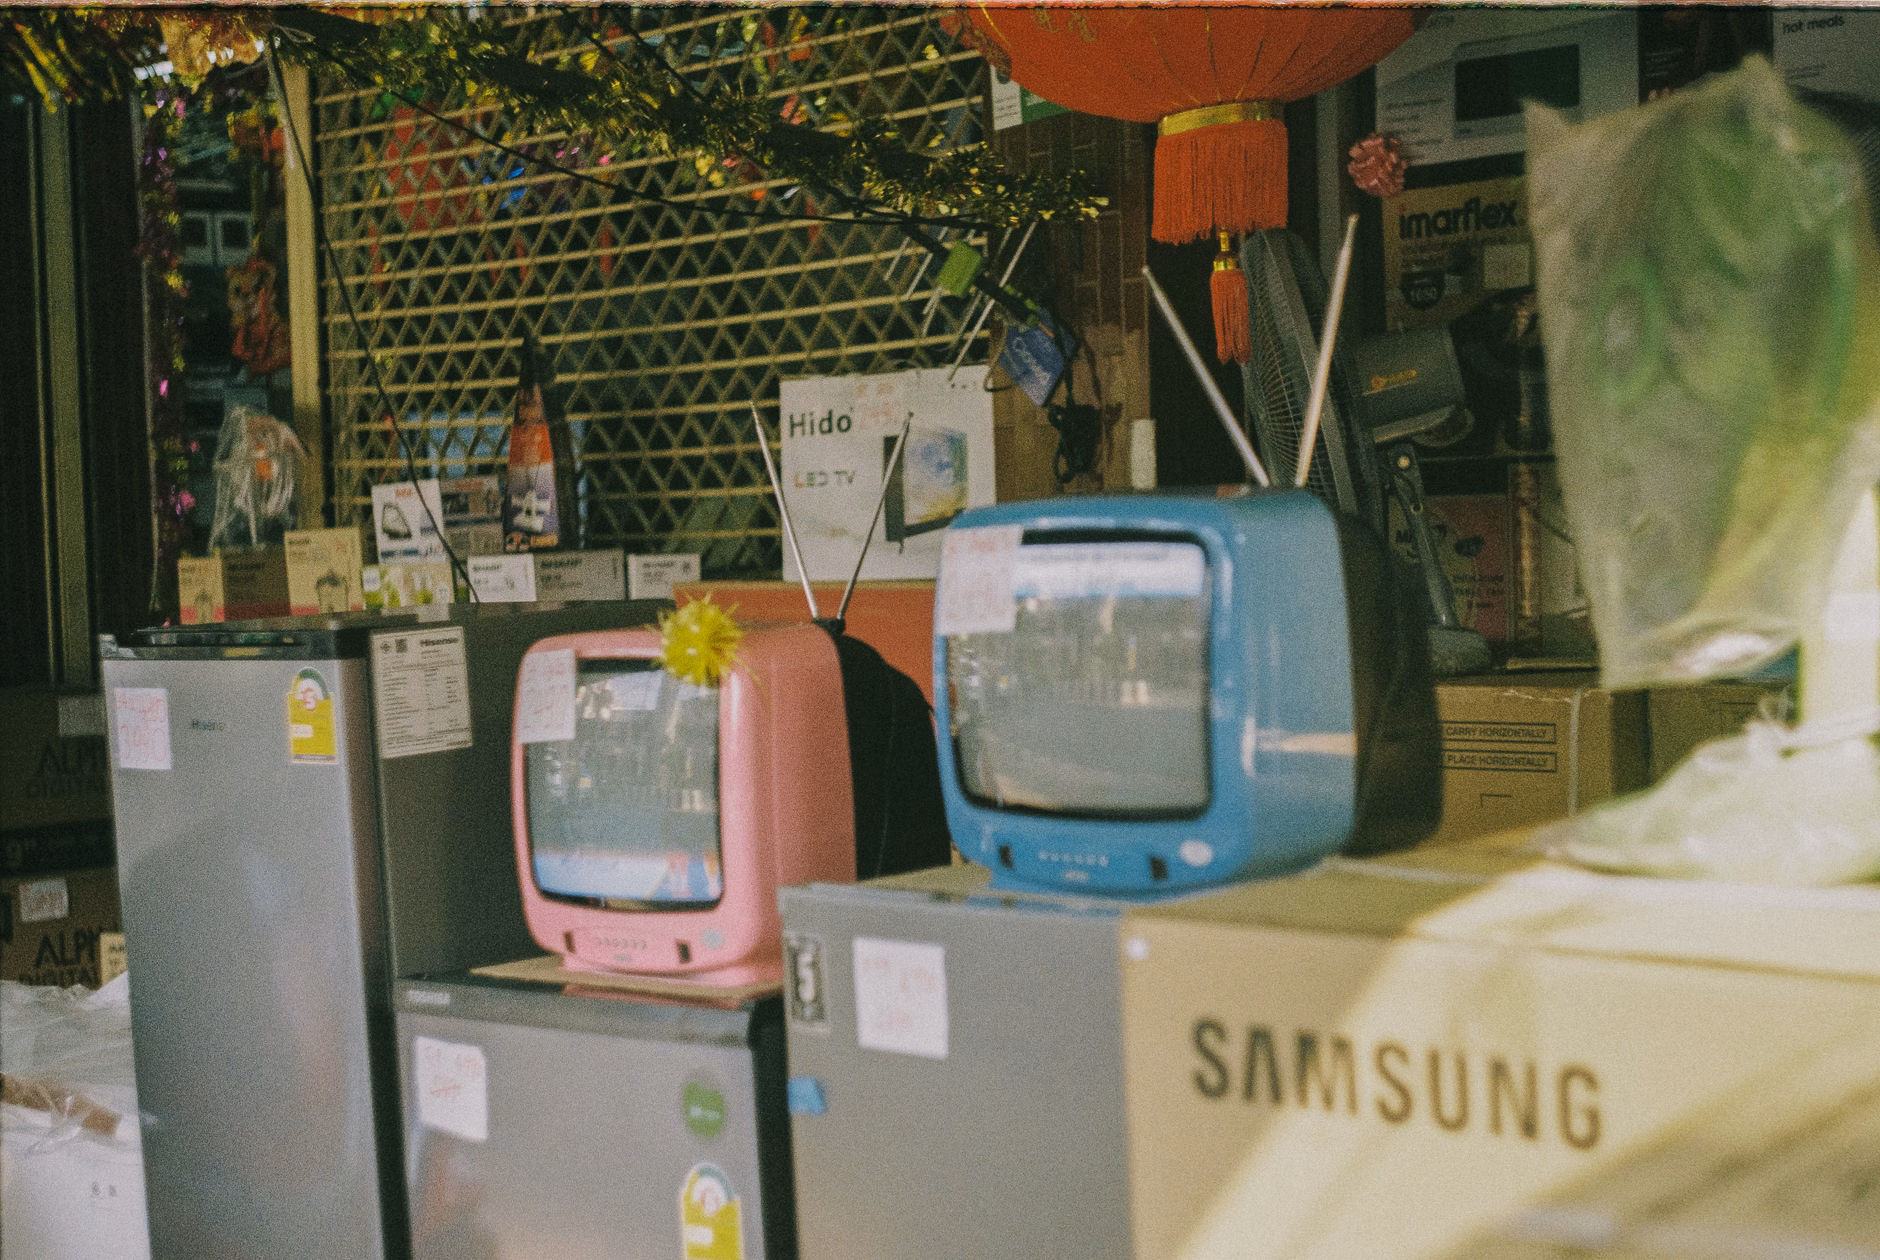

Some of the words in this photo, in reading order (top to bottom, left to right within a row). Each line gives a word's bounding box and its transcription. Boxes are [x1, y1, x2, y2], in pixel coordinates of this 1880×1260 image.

[1782, 20, 1803, 33] hot
[1806, 15, 1844, 29] meals
[1399, 197, 1518, 239] imarflex
[789, 408, 853, 439] Hido
[793, 470, 828, 488] LED
[834, 468, 856, 484] TV
[1446, 727, 1476, 737] CARRY
[1479, 727, 1547, 739] HORIZONTALLY
[1447, 754, 1476, 765] PLACE
[1479, 756, 1548, 768] HORIZONTALLY
[1190, 1015, 1602, 1152] SAMSUNG
